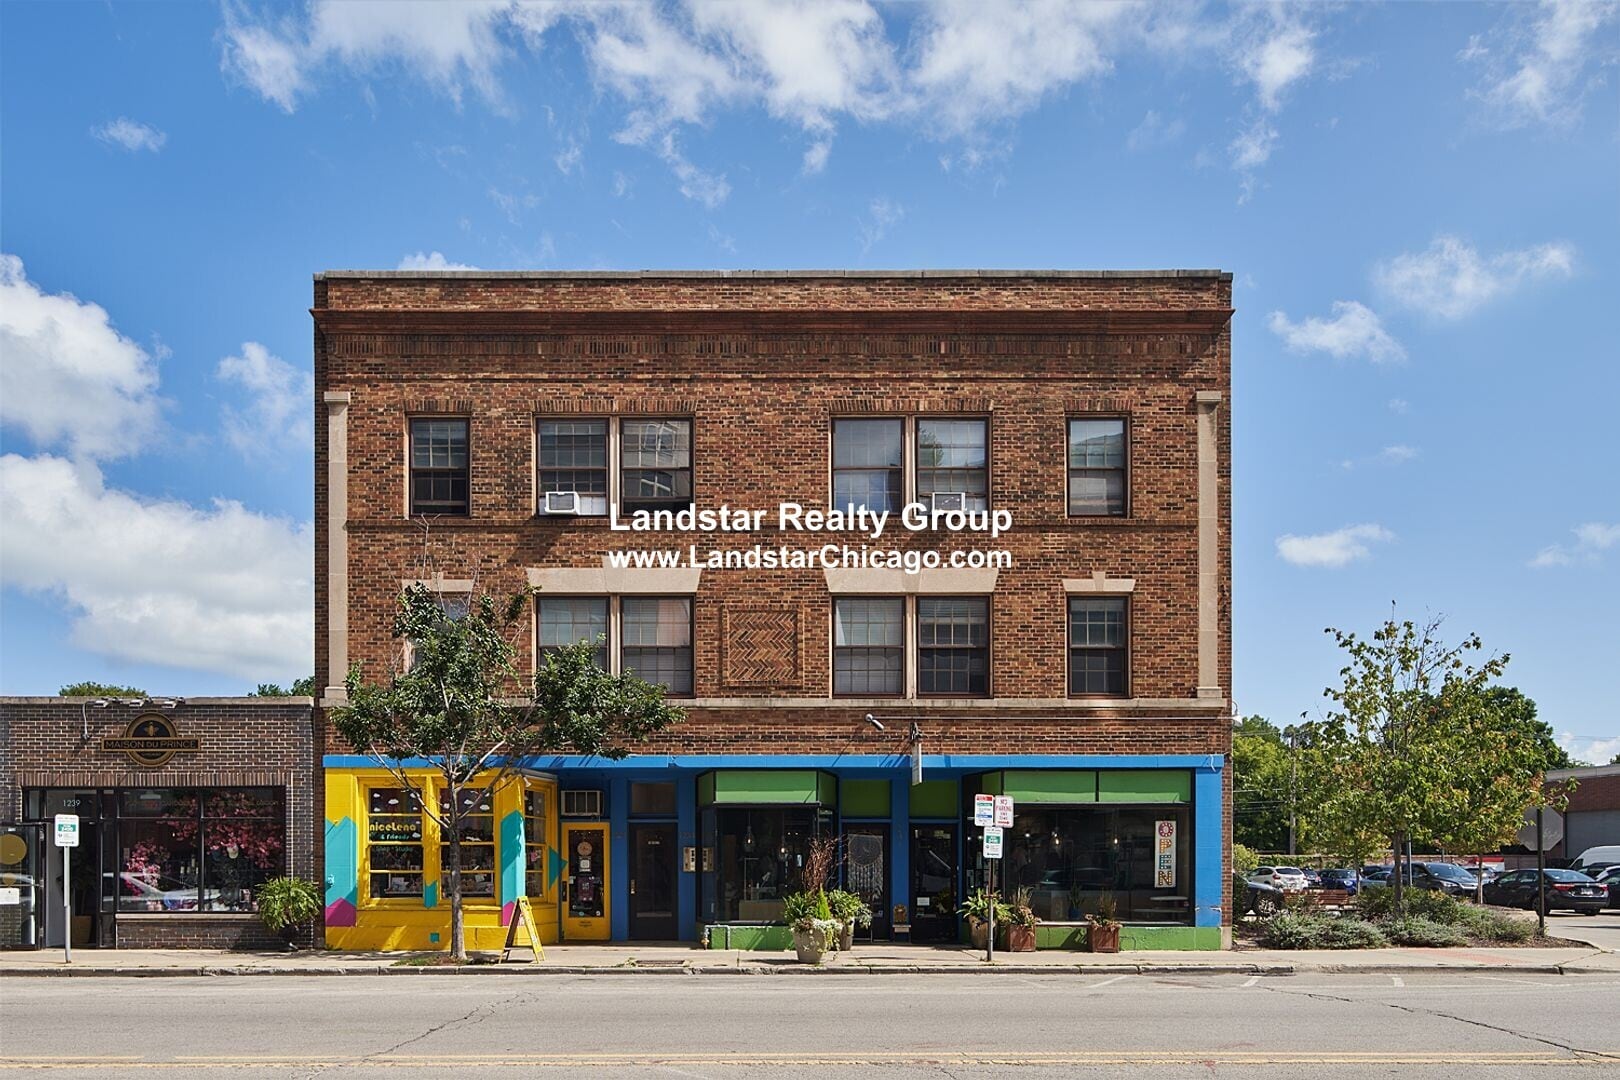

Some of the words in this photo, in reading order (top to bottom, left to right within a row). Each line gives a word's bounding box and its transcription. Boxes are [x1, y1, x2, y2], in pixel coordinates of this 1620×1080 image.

[105, 740, 144, 748] MAISON
[146, 740, 158, 748] DU
[160, 740, 197, 748] PRINCE
[63, 799, 80, 807] 1239
[1158, 821, 1174, 887] OPEN
